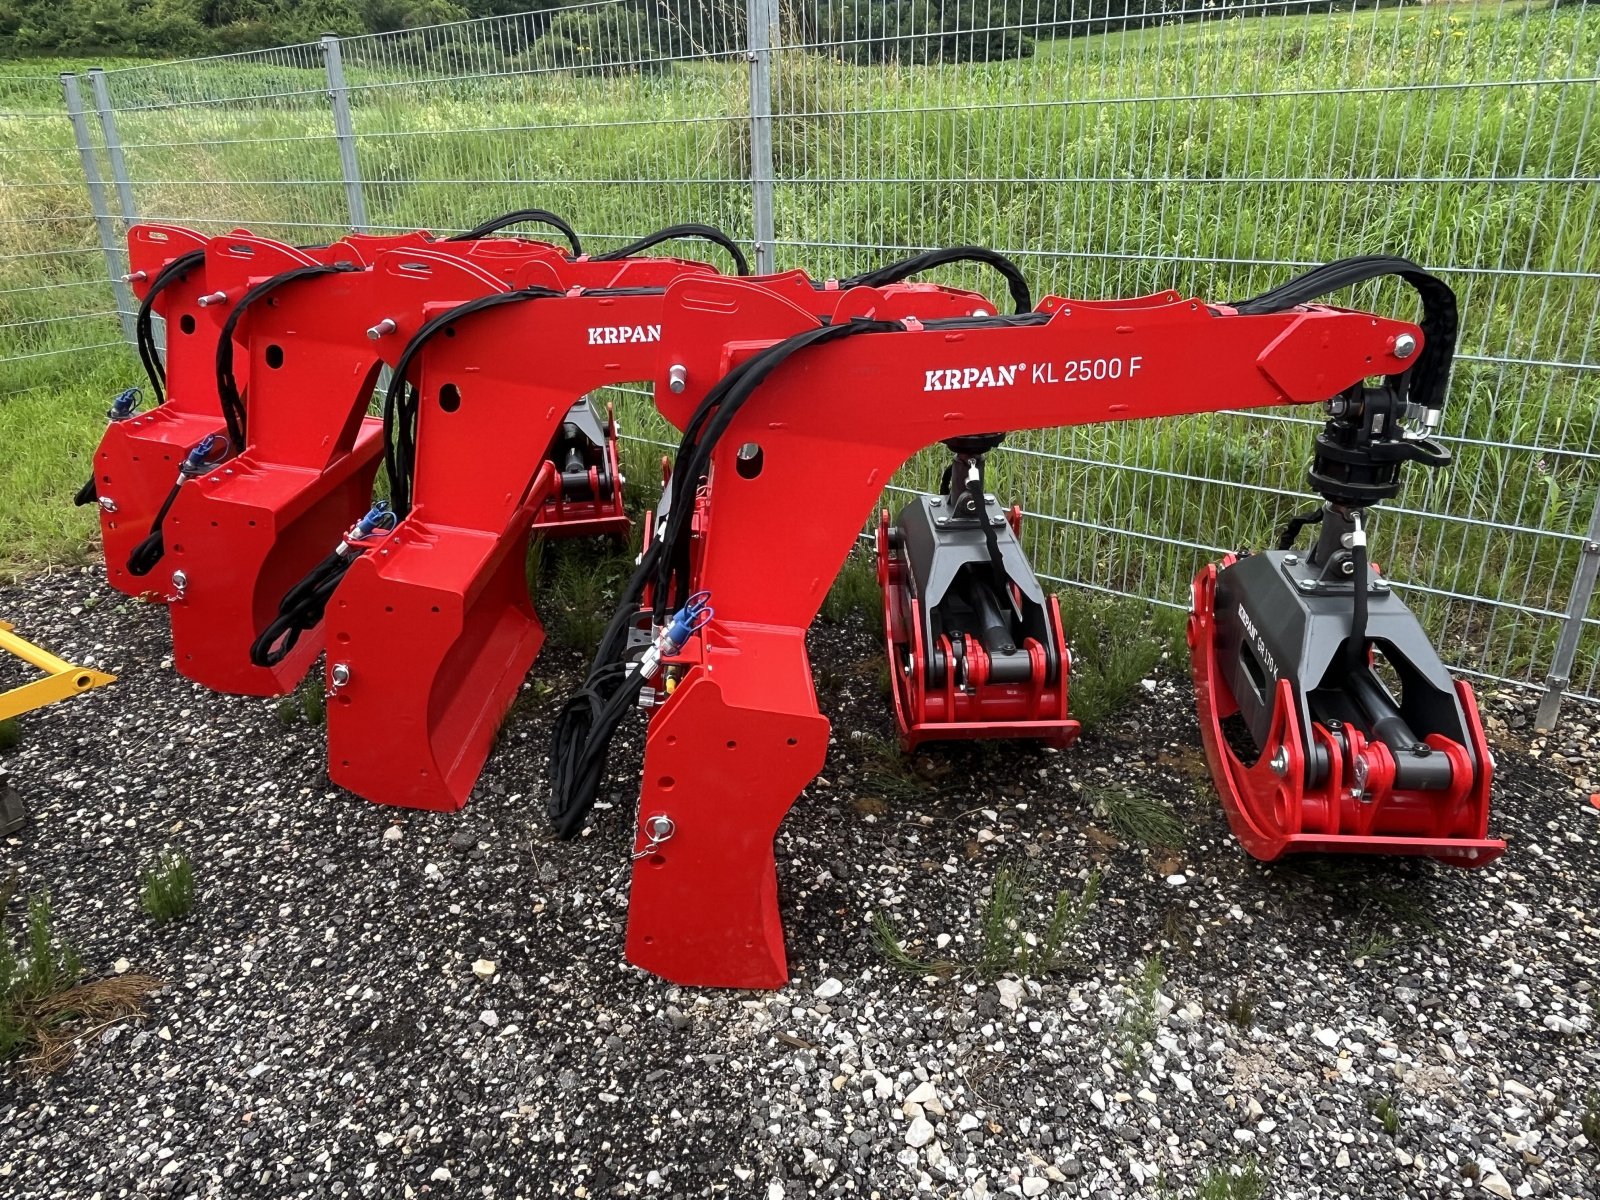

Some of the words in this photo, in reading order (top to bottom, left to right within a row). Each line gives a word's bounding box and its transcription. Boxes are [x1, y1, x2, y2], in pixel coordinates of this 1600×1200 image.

[588, 324, 661, 345] KRPAN
[1032, 362, 1058, 384] KL
[1065, 358, 1122, 382] 2500
[1129, 356, 1143, 378] F
